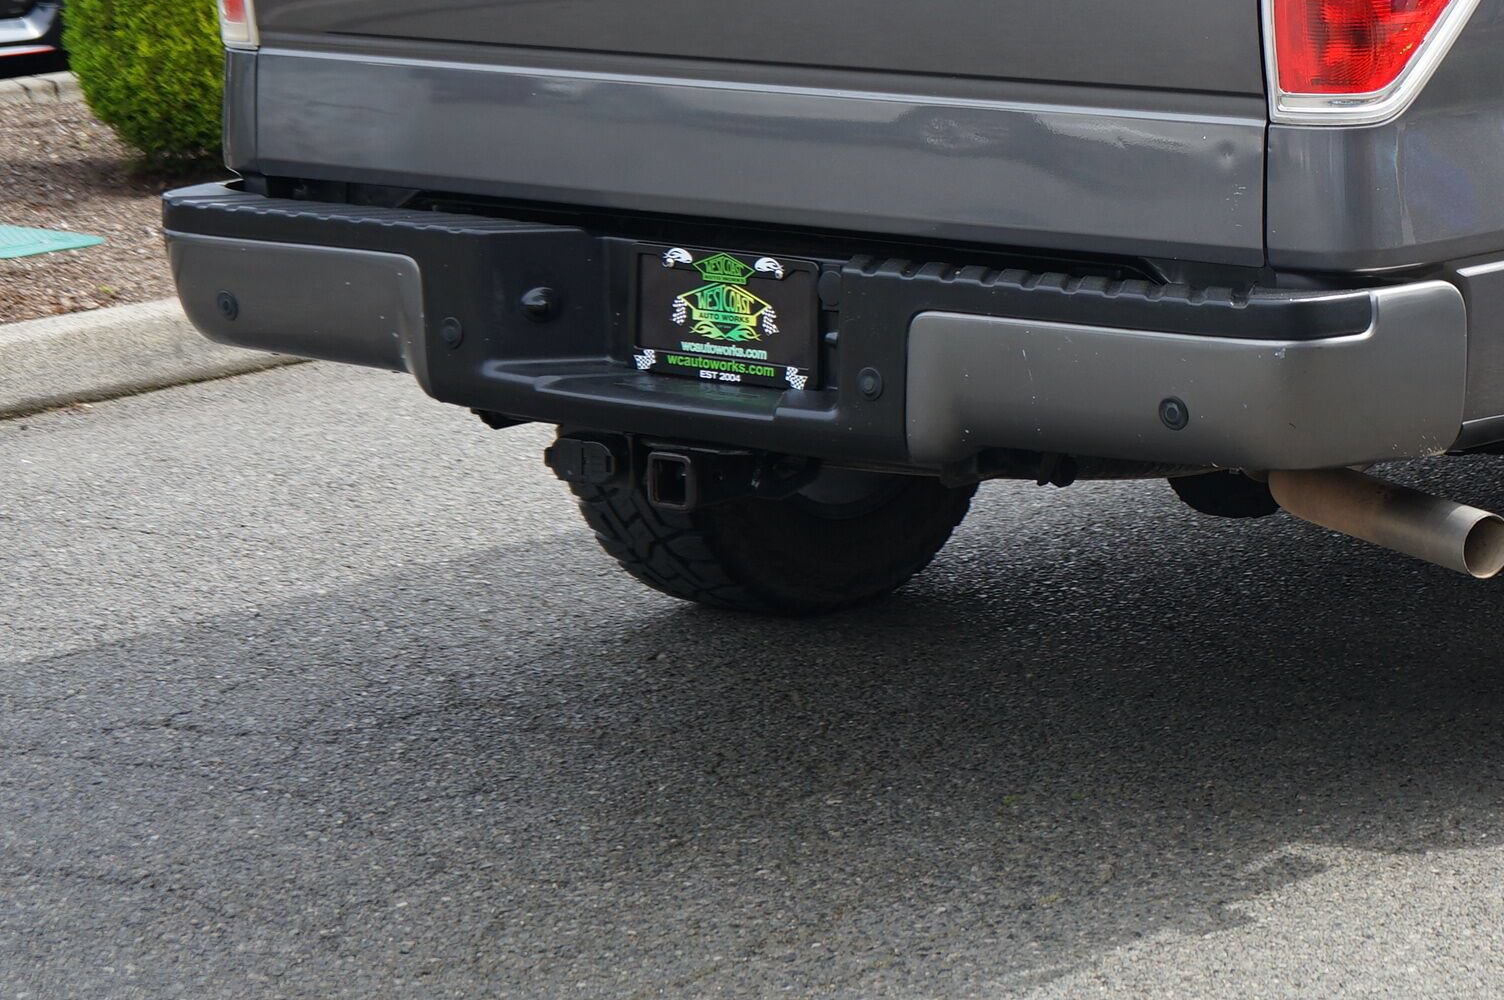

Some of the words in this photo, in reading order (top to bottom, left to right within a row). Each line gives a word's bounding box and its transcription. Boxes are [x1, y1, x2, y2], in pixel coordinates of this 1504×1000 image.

[695, 284, 724, 311] WEST
[723, 285, 755, 314] COAST
[699, 312, 719, 320] AUTO
[721, 314, 749, 324] WORKS
[681, 340, 768, 360] wcautoworks.com
[667, 354, 775, 377] wcautoworks.com
[699, 369, 717, 380] EST
[719, 372, 742, 382] 2004
